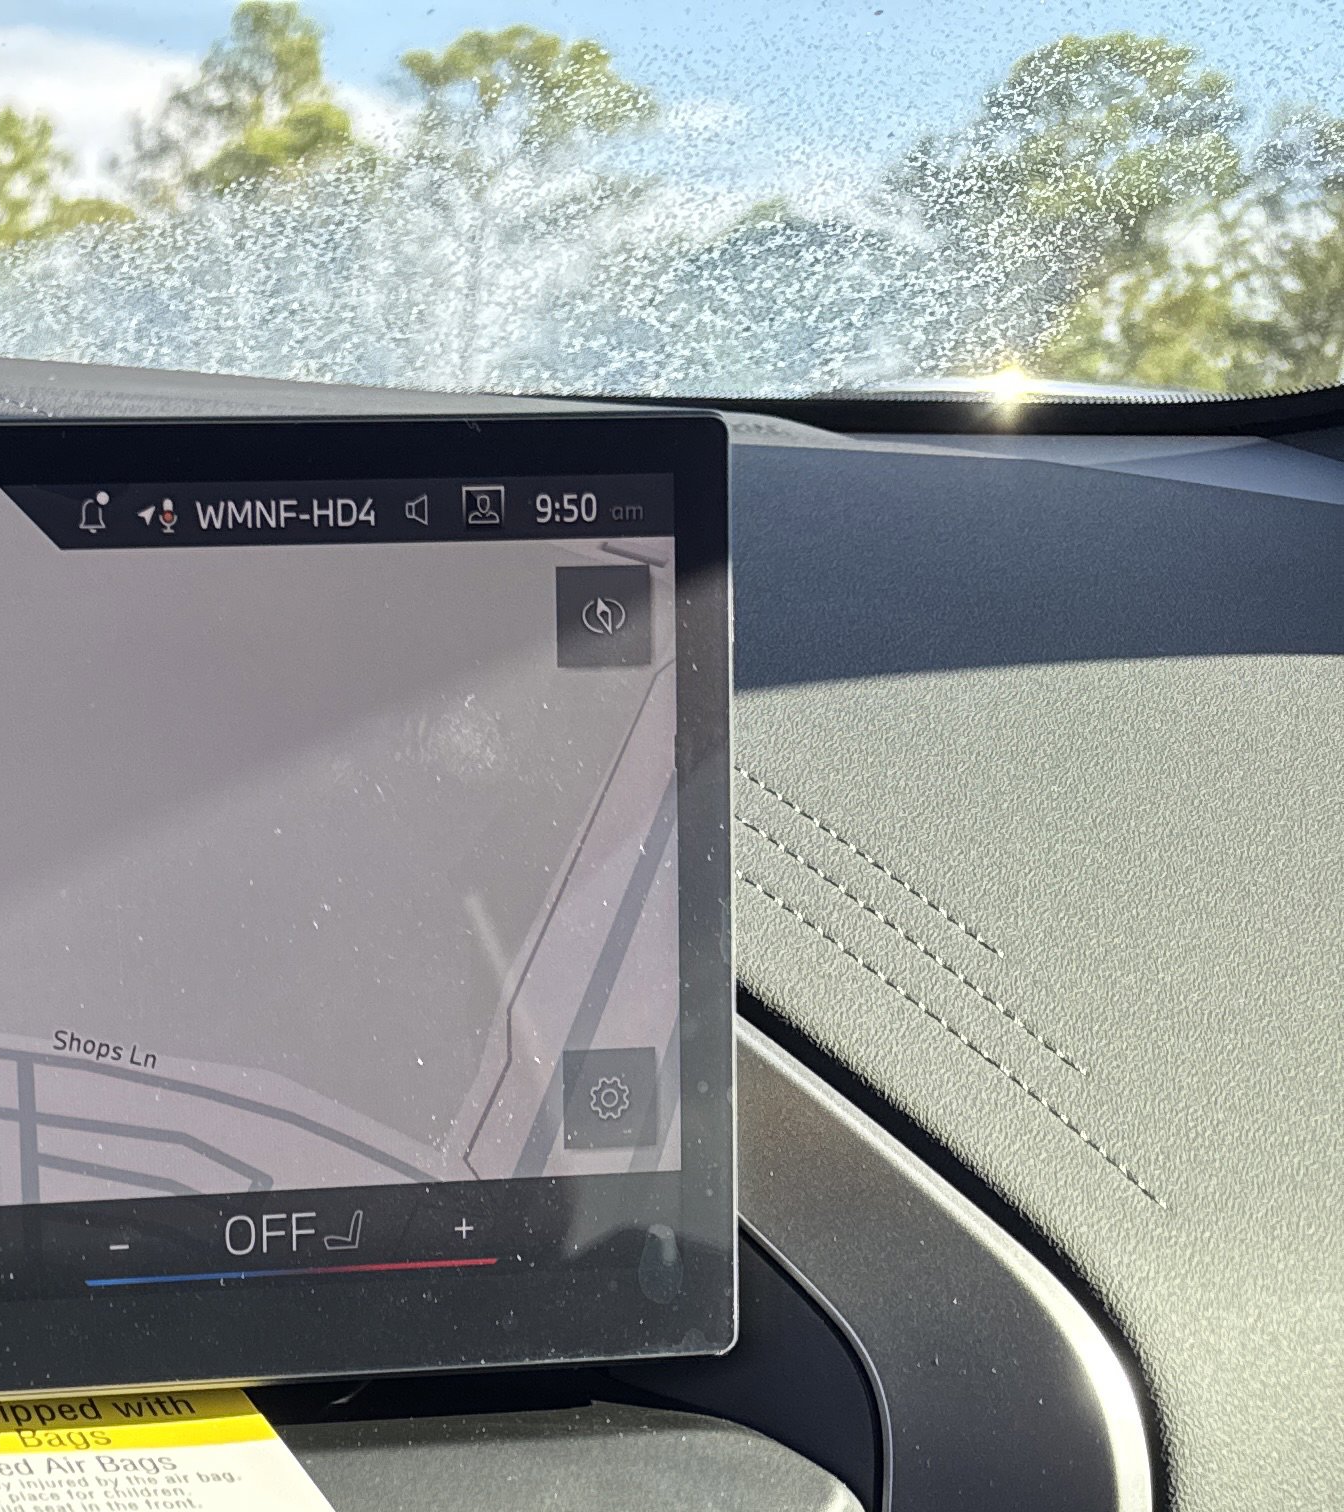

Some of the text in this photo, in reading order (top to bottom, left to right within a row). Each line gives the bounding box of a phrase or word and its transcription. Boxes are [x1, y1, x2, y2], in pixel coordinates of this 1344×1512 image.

[195, 497, 376, 529] WMNF-HD4
[535, 492, 643, 523] 9:50 am
[53, 1030, 157, 1069] Shops Ln
[225, 1211, 316, 1255] OFF
[113, 1395, 197, 1418] with
[15, 1427, 112, 1450] Bags
[46, 1456, 85, 1475] Air
[95, 1454, 177, 1475] Bags
